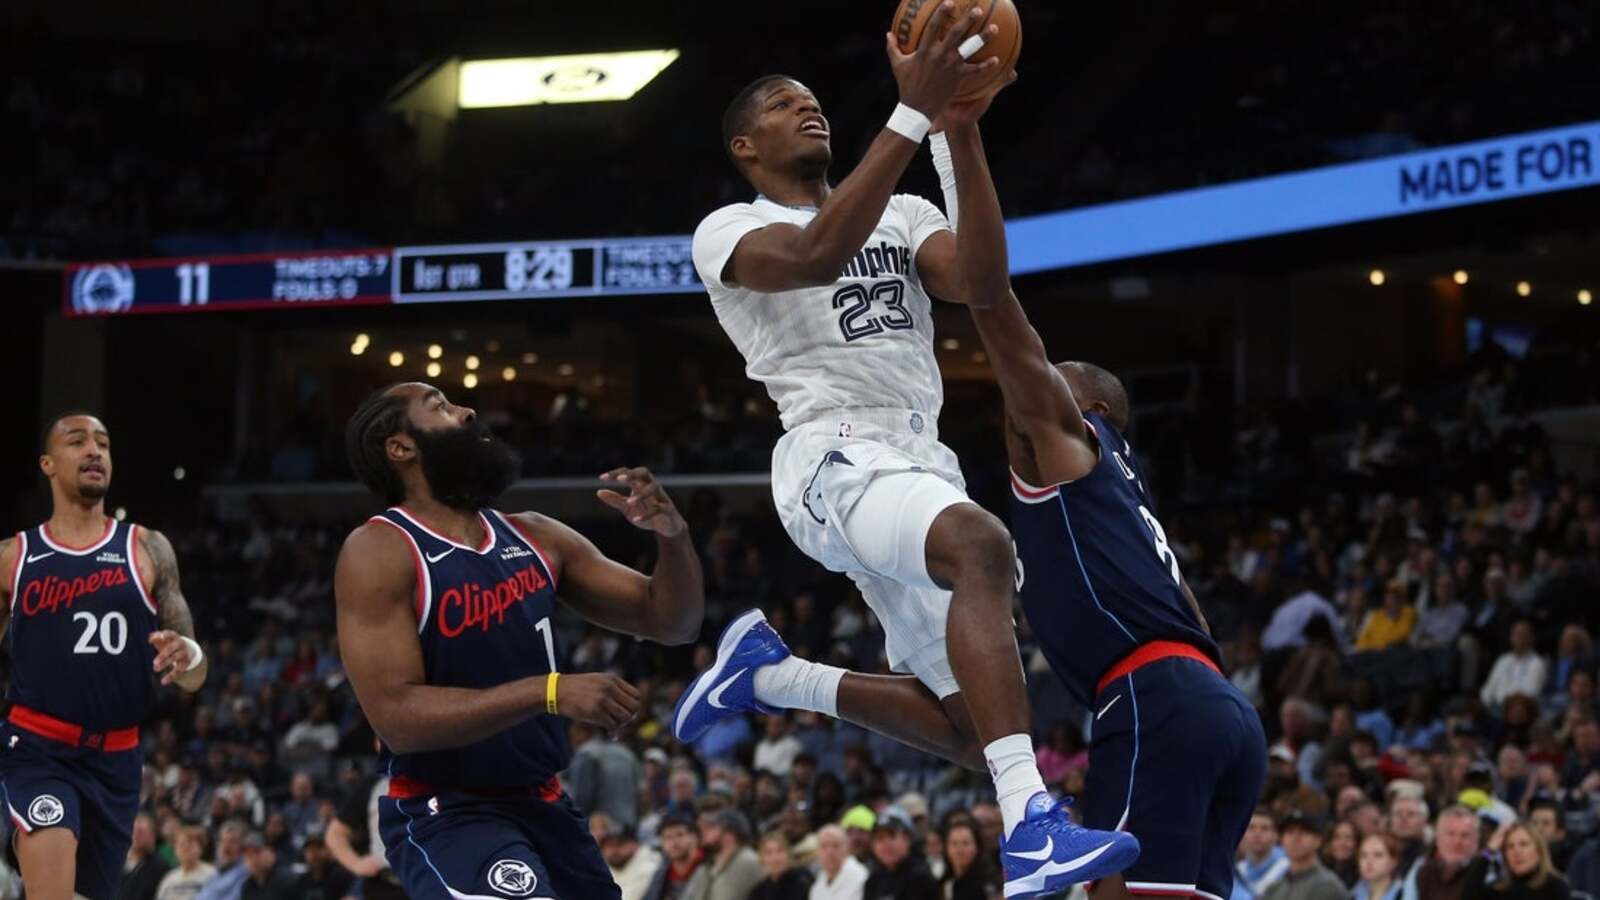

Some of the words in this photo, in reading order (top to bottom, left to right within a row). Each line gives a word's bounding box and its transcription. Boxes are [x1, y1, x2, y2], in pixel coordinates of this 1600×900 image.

[1399, 152, 1504, 204] MADE
[1516, 137, 1592, 187] FOR
[176, 262, 210, 306] 11
[504, 248, 573, 292] 8:29
[842, 241, 911, 278] mphis
[832, 279, 914, 342] 23
[22, 566, 128, 616] Clippers
[437, 562, 547, 639] Clippers
[73, 611, 128, 655] 20
[535, 616, 557, 673] 1
